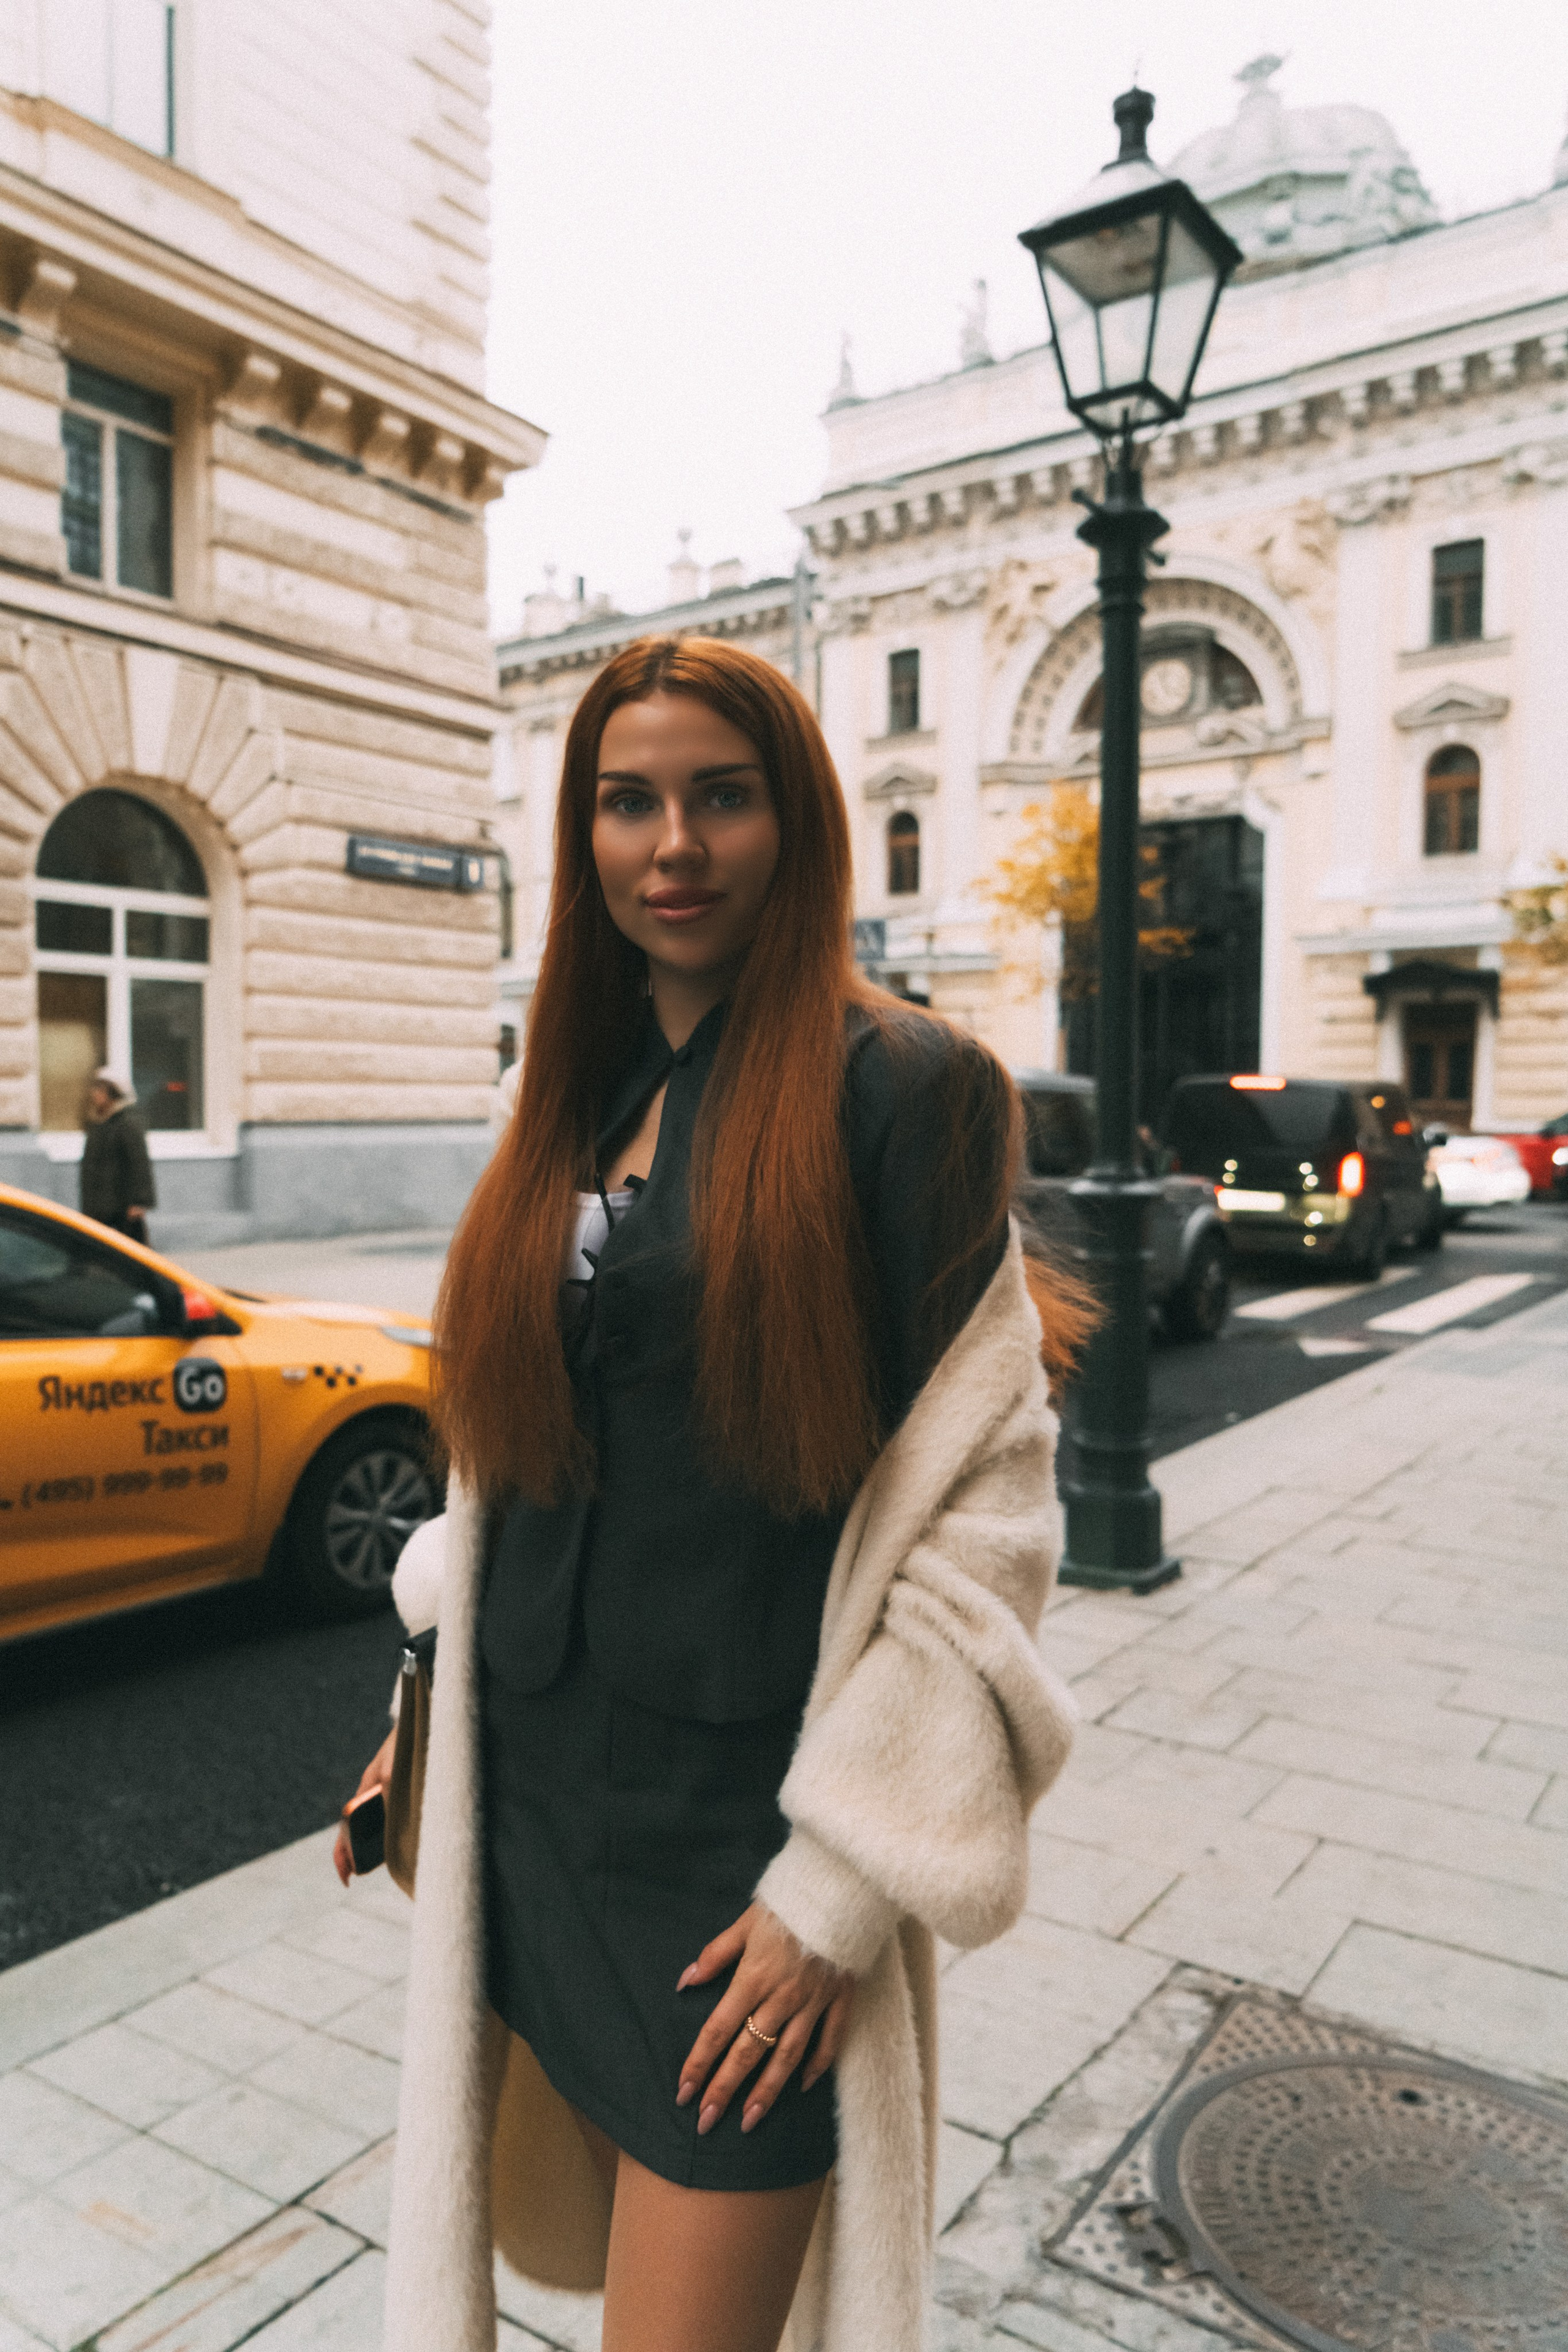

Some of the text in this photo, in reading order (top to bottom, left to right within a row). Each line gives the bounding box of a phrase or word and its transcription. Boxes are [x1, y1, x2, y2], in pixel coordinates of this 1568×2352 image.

[37, 1366, 224, 1413] Яндекс Go
[140, 1419, 230, 1456] Такси
